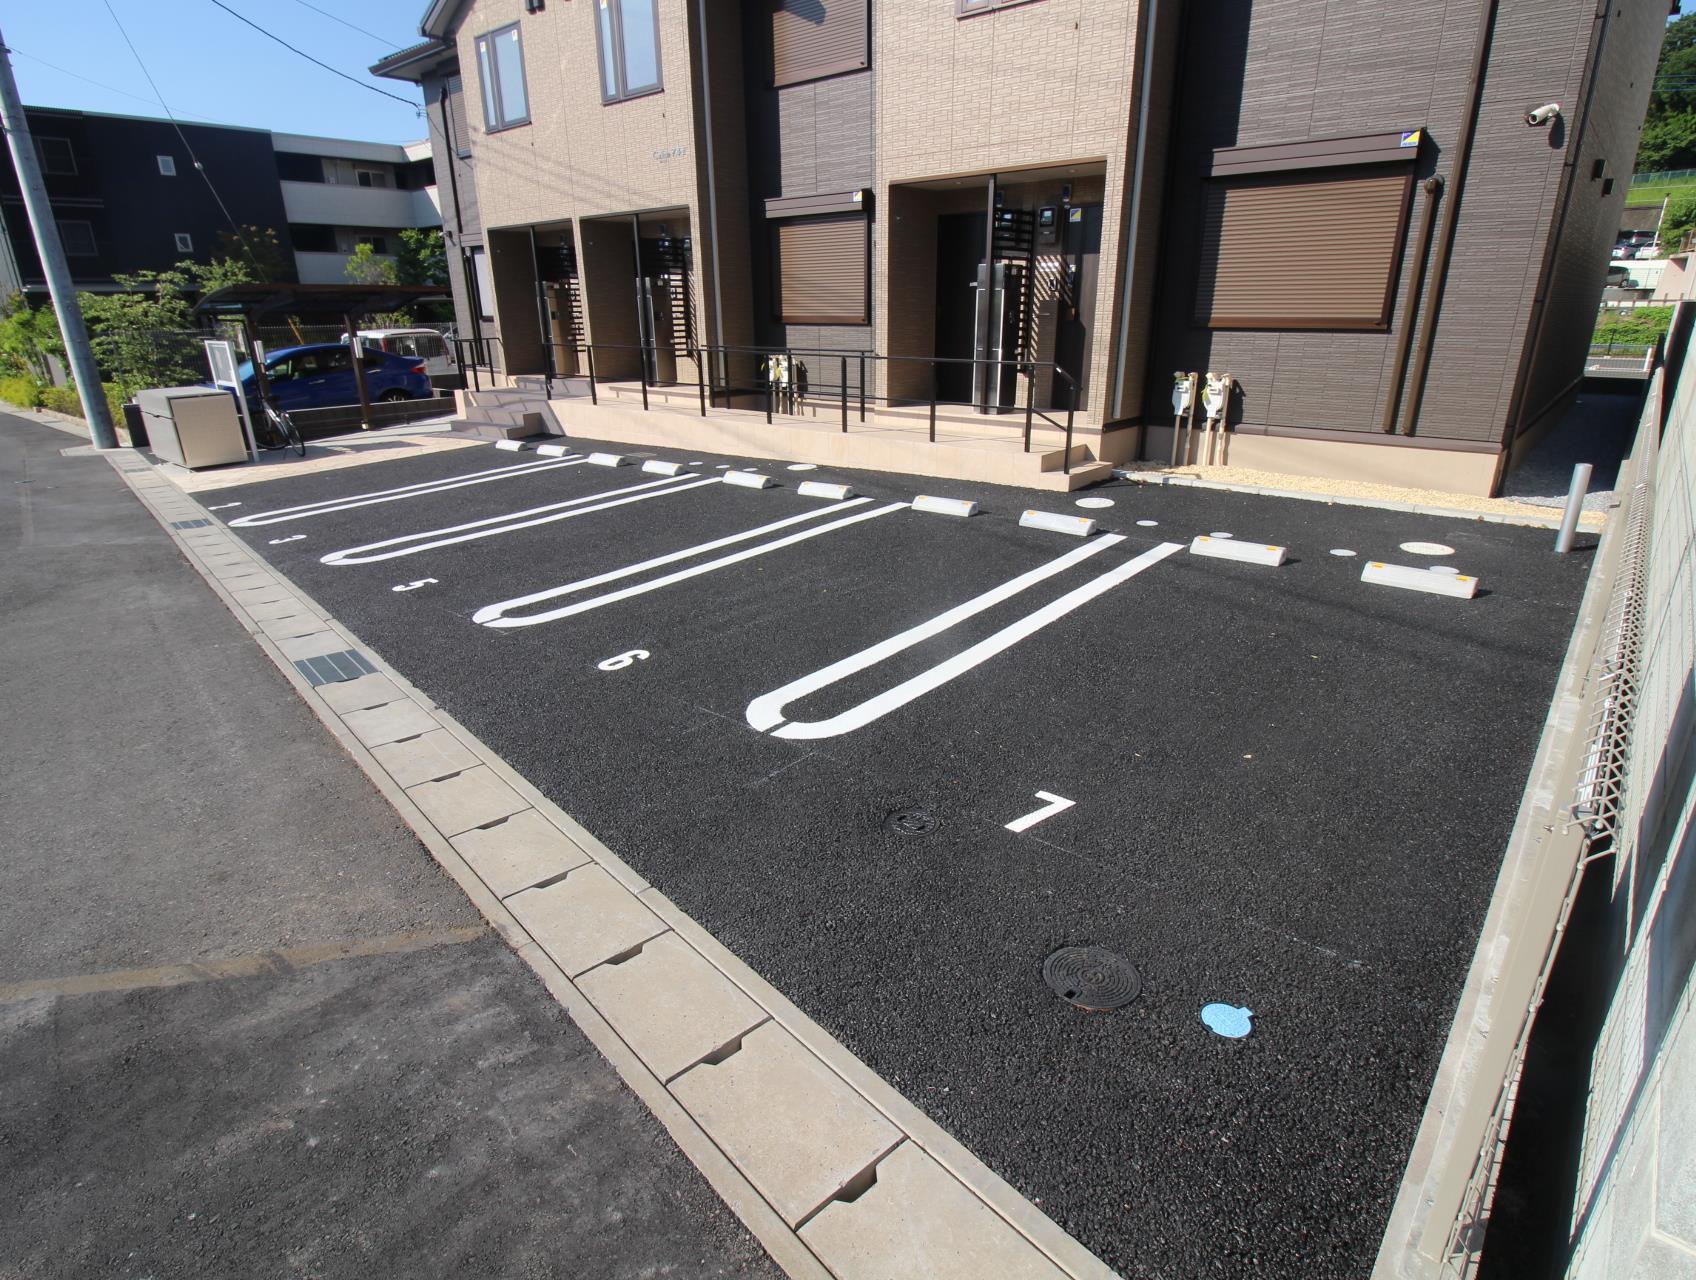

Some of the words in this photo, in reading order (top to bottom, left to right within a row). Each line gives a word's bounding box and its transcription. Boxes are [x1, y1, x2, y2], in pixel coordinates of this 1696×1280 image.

[269, 534, 307, 545] 3
[392, 578, 439, 592] 5
[598, 650, 650, 671] 6
[1004, 790, 1077, 833] 7
